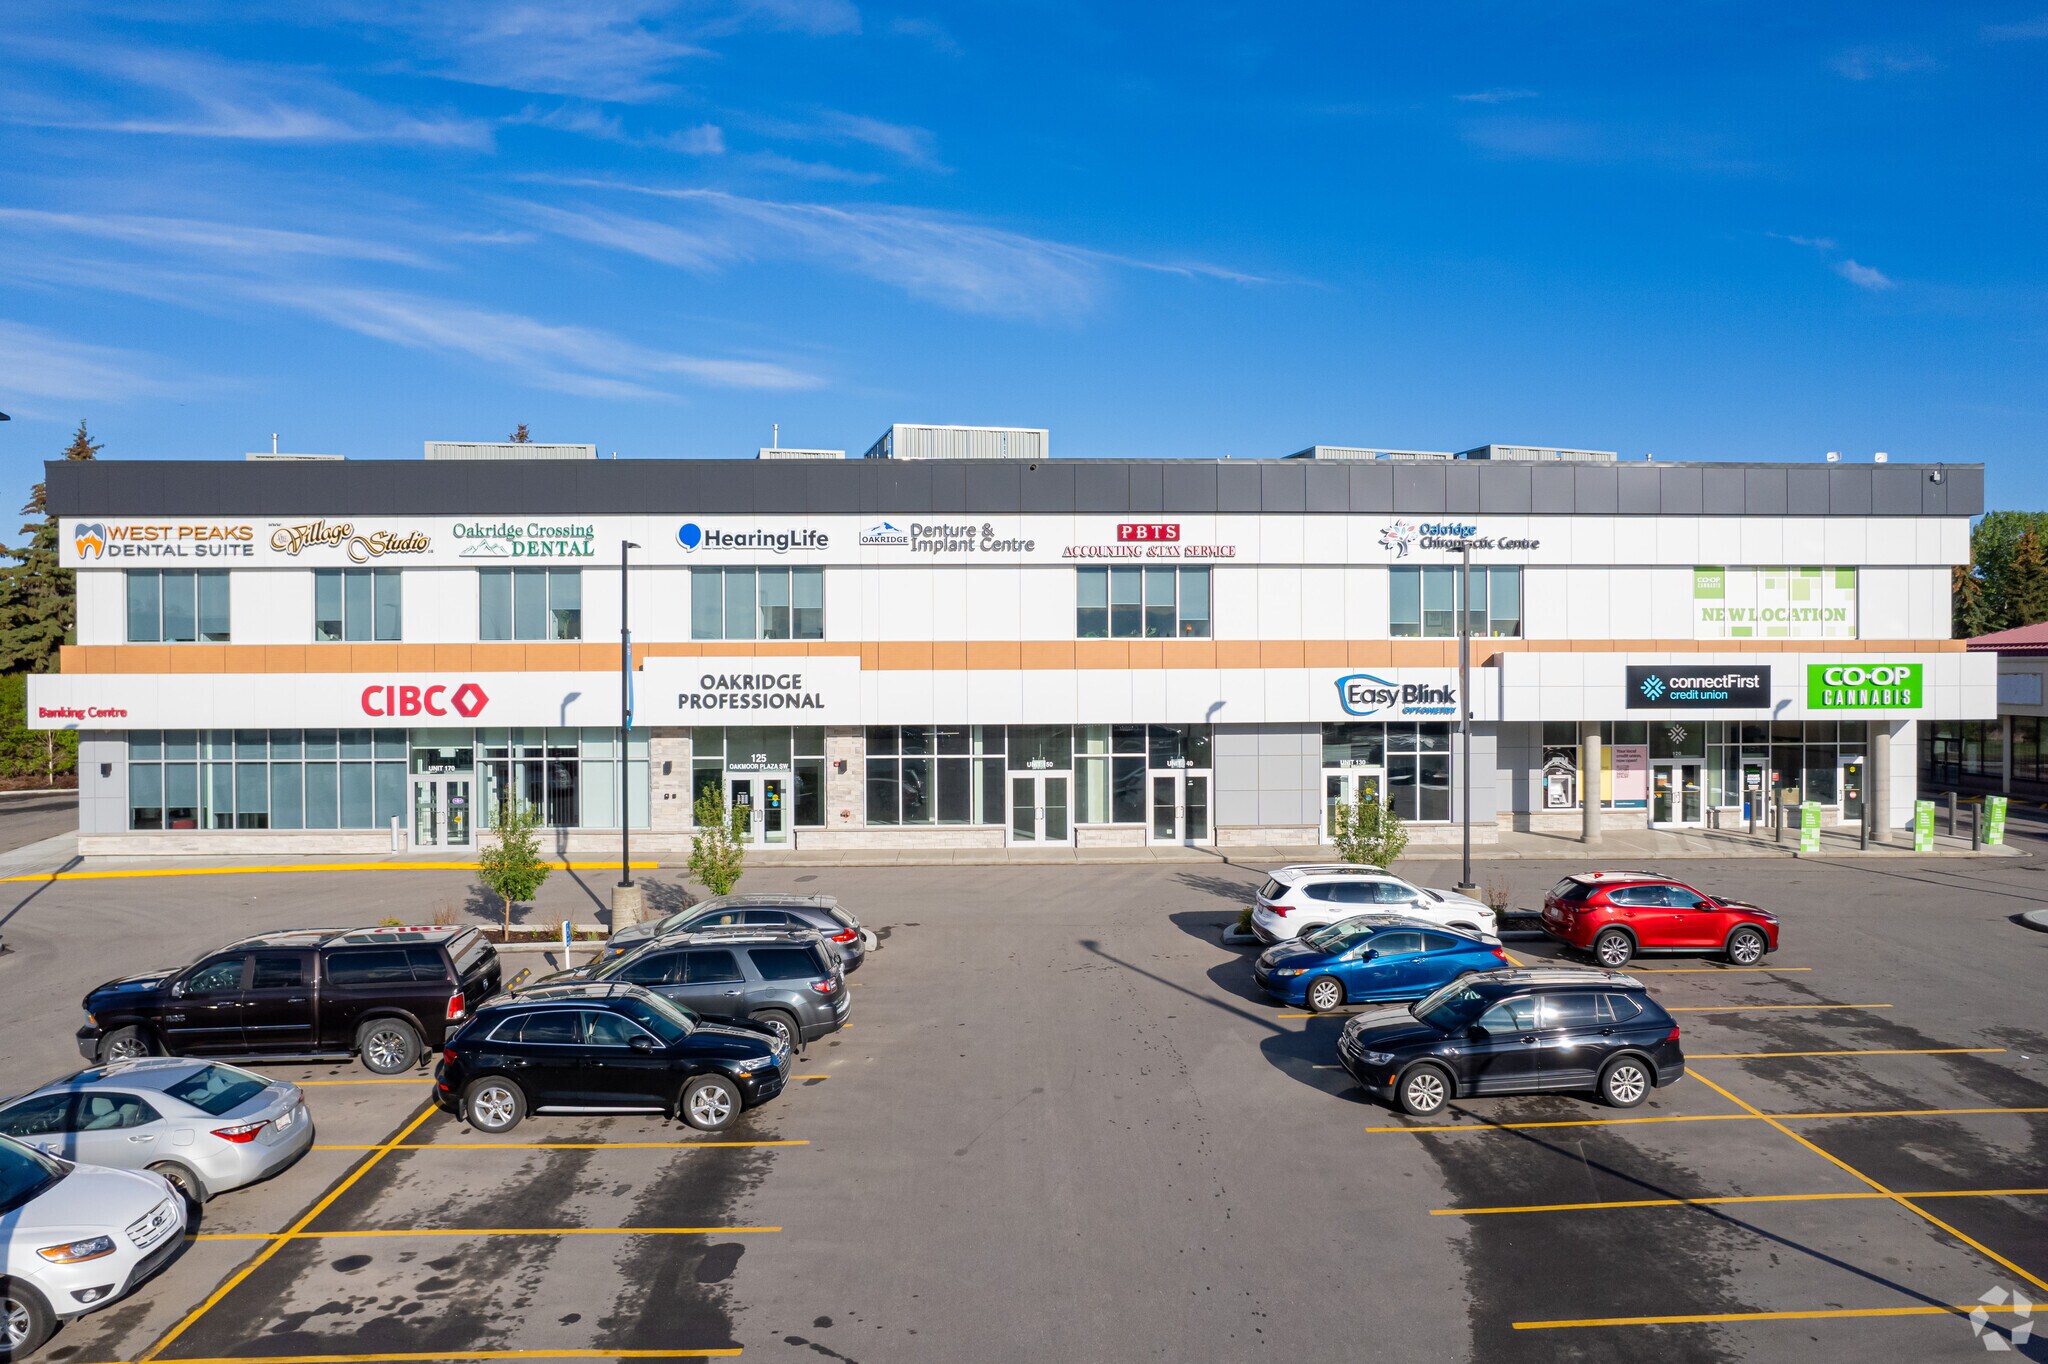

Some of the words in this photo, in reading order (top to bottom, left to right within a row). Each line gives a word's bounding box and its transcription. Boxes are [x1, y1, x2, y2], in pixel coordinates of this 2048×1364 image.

[107, 525, 172, 541] WEST
[177, 525, 255, 541] PEAKS
[270, 519, 354, 556] Village
[452, 523, 523, 541] Oakridge
[526, 523, 595, 541] Crossing
[910, 523, 977, 538] Denture
[981, 523, 995, 538] &
[1121, 525, 1177, 539] PBTS
[1419, 522, 1477, 539] Oakridge
[347, 530, 431, 563] Studio
[704, 529, 829, 550] HearingLife
[910, 537, 975, 555] Implant
[980, 537, 1036, 552] Centre
[1497, 536, 1541, 550] Centre
[108, 543, 189, 557] DENTAL
[189, 543, 255, 557] SUITE
[511, 540, 595, 557] DENTAL
[1062, 545, 1142, 558] ACCOUNTING
[1184, 545, 1236, 558] SERVICE
[1702, 607, 1746, 621] NEW
[1749, 607, 1846, 621] LOCATION
[700, 674, 802, 690] OAKRIDGE
[1669, 674, 1760, 688] connectFirst
[361, 685, 447, 717] CIBC
[678, 693, 825, 709] PROFESSIONAL
[1347, 684, 1400, 708] Easy
[1402, 683, 1456, 704] Blink
[1670, 690, 1699, 700] credit
[1700, 690, 1728, 700] union
[1823, 689, 1911, 705] CANNABIS
[38, 706, 86, 720] Banking
[88, 706, 128, 718] Centre
[751, 754, 767, 763] 125
